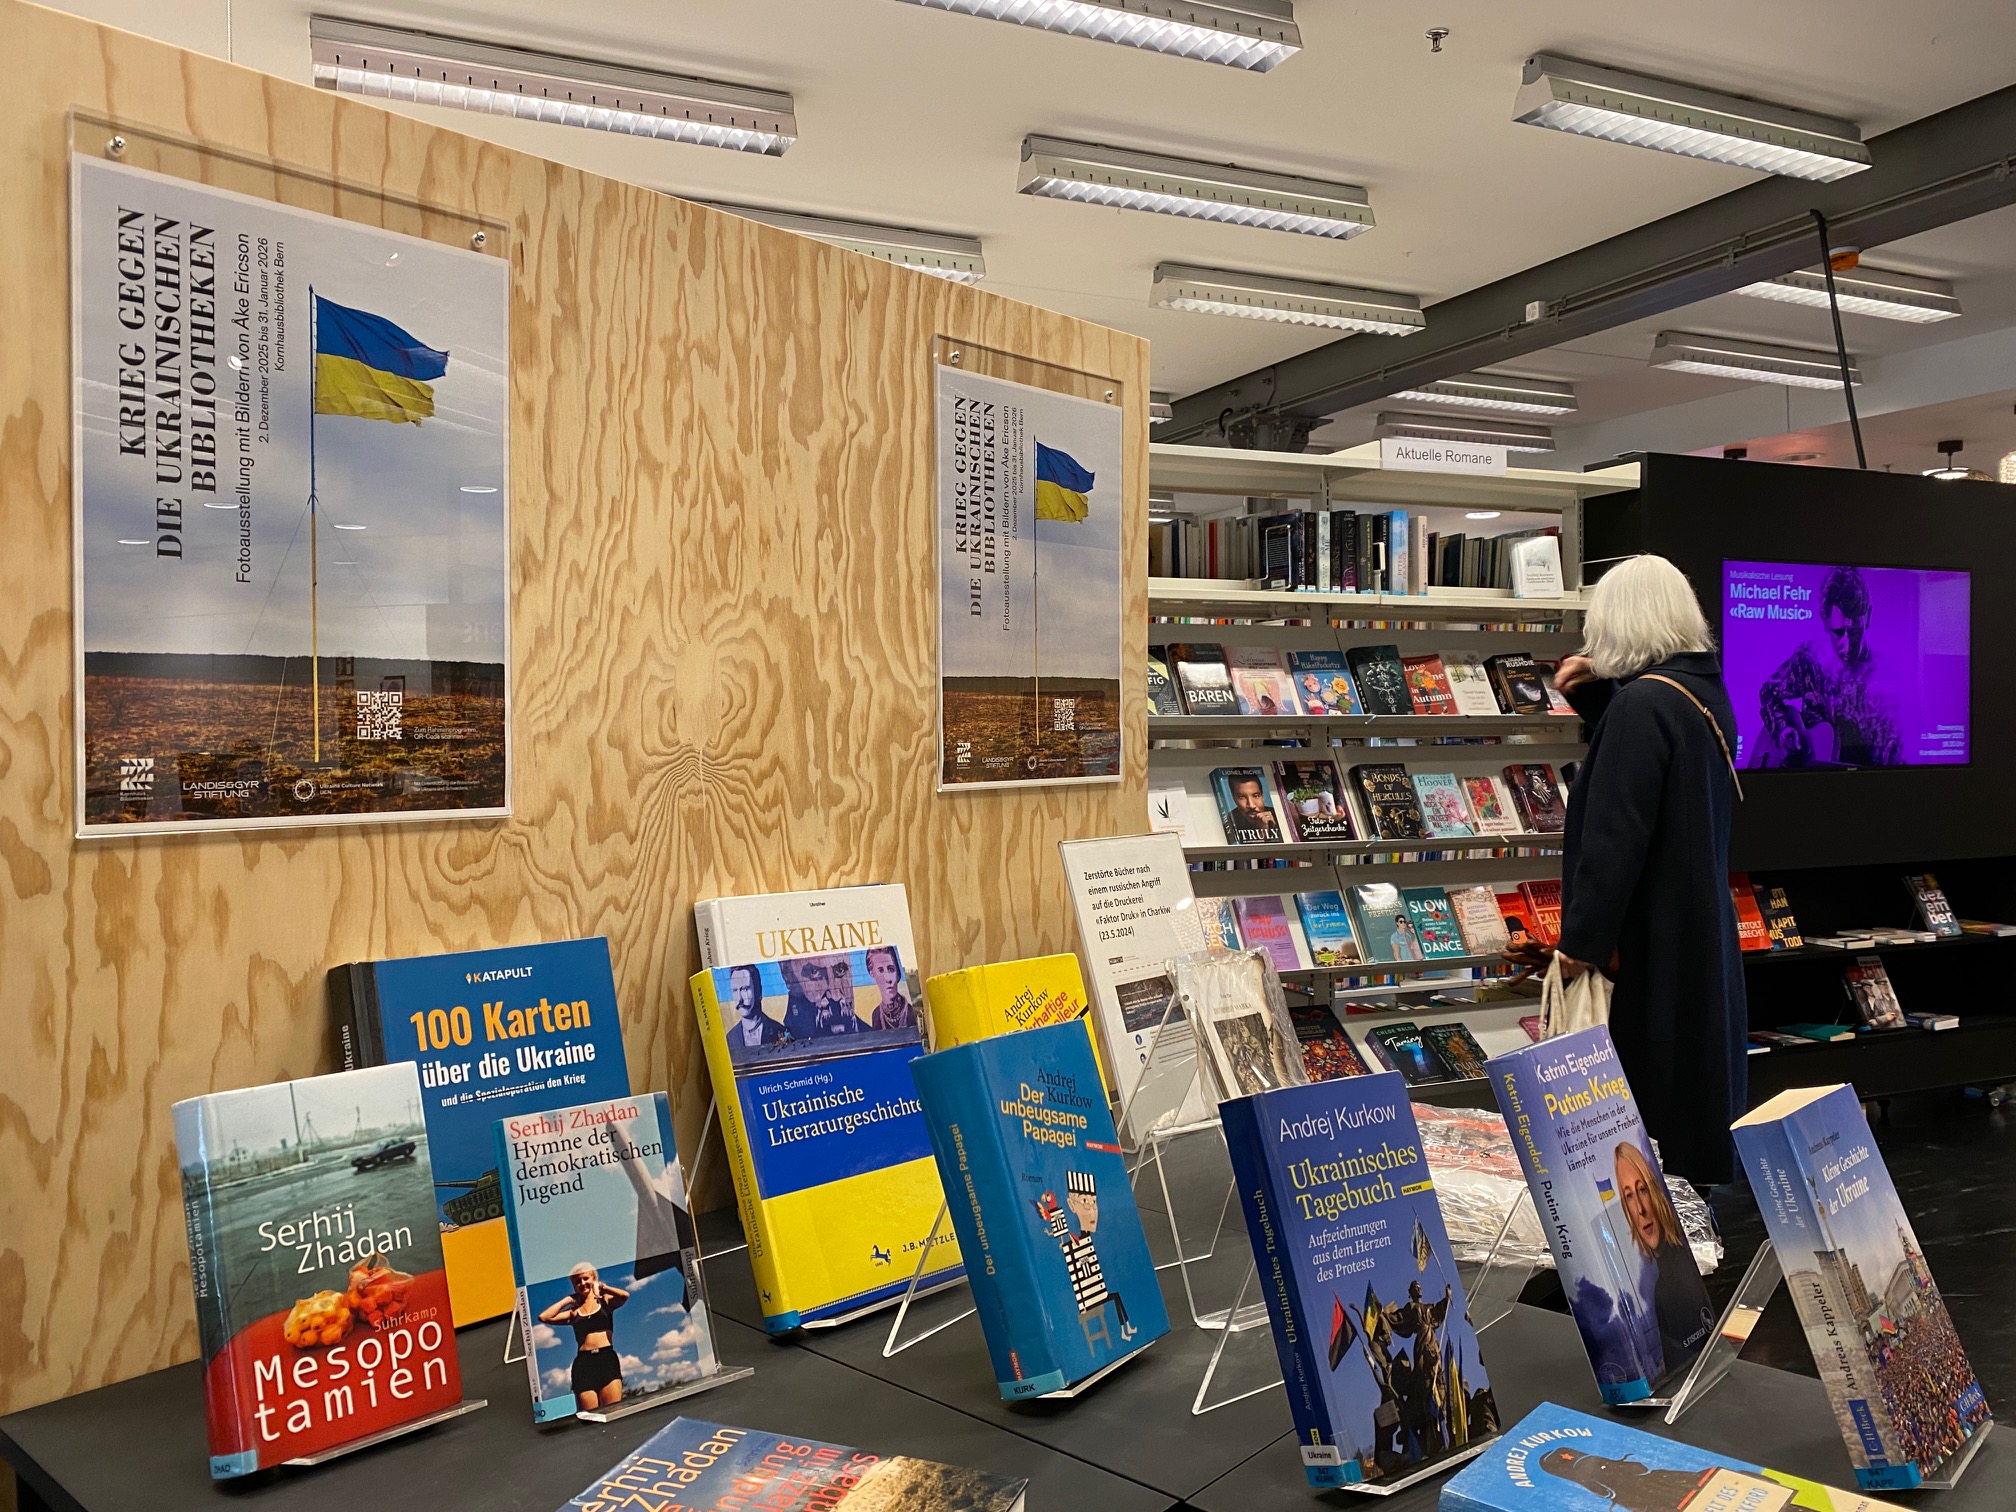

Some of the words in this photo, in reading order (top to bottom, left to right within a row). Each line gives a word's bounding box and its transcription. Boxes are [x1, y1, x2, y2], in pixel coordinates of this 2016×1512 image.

[118, 205, 145, 330] GEGEN
[234, 234, 250, 294] Ericson
[258, 238, 268, 268] 2026
[274, 242, 284, 268] Bern
[258, 272, 268, 307] Januar
[231, 298, 250, 330] Åke
[258, 311, 268, 324] 31.
[274, 270, 284, 372] Kornhausbibliothek
[154, 213, 182, 484] UKRAINISCHEN
[239, 334, 250, 362] von
[258, 327, 269, 342] bis
[189, 222, 216, 494] BIBLIOTHEKEN
[258, 344, 269, 374] 2025
[118, 343, 146, 458] KRIEG
[234, 366, 250, 423] Bildern
[258, 375, 270, 431] Dezember
[235, 427, 250, 453] mit
[955, 395, 967, 473] GEGEN
[1396, 447, 1442, 461] Aktuelle
[1446, 450, 1492, 464] Romane
[969, 399, 981, 570] UKRAINISCHEN
[984, 403, 995, 574] BIBLIOTHEKEN
[156, 497, 183, 560] DIE
[236, 457, 254, 583] Fotoausstellung
[956, 482, 967, 553] KRIEG
[971, 578, 981, 617] DIE
[1003, 552, 1011, 631] Fotoausstellung
[1730, 582, 1780, 600] Michael
[1784, 586, 1812, 600] Fehr
[1730, 603, 1764, 619] «Raw
[1768, 604, 1812, 620] Music»
[1189, 690, 1234, 702] BÄREN
[1413, 692, 1452, 704] Autumn
[183, 781, 259, 791] LANDIS&GYR
[194, 790, 249, 798] STIFTUNG
[1371, 773, 1401, 783] BONDS
[1372, 792, 1412, 801] HERCULES
[1238, 828, 1279, 840] TRULY
[1084, 870, 1113, 880] Zerstörte
[1114, 867, 1135, 876] Bücher
[1137, 864, 1150, 873] nach
[1088, 886, 1108, 895] einem
[1109, 881, 1140, 892] russischen
[1142, 877, 1161, 888] Angriff
[1092, 900, 1102, 910] auf
[1104, 899, 1114, 908] die
[1115, 894, 1144, 907] Druckerei
[1305, 904, 1320, 912] Der
[1322, 903, 1338, 911] Weg
[1409, 899, 1447, 913] SLOW
[1919, 887, 1945, 901] dez
[1926, 901, 1950, 912] em
[1096, 915, 1119, 925] «Faktor
[1121, 911, 1139, 921] Druk»
[1140, 910, 1146, 918] in
[1147, 906, 1170, 916] Charkiw
[1739, 929, 1765, 938] BRECHT
[1928, 912, 1952, 925] ber
[755, 920, 883, 959] UKRAINE
[1099, 926, 1134, 942] (23.5.2024)
[1423, 940, 1463, 953] DANCE
[473, 966, 532, 983] KATAPULT
[1005, 986, 1033, 1022] Andrej
[1015, 989, 1048, 1027] Kurkow
[410, 1006, 472, 1052] 100
[482, 998, 591, 1042] Karten
[1384, 1036, 1422, 1052] Taming
[1534, 1059, 1568, 1084] Katrin
[1565, 1039, 1614, 1075] Eigendorf
[422, 1062, 471, 1088] über
[479, 1052, 510, 1079] die
[516, 1041, 596, 1072] Ukraine
[1037, 1068, 1077, 1092] Andrej
[442, 1095, 458, 1107] und
[546, 1077, 562, 1088] den
[564, 1073, 586, 1086] Krieg
[758, 1082, 783, 1095] Ulrich
[783, 1076, 813, 1092] Schmid
[815, 1073, 833, 1086] (Hg.)
[1020, 1083, 1044, 1104] Der
[1048, 1086, 1093, 1109] Kurkow
[1544, 1086, 1593, 1120] Putins
[1588, 1073, 1630, 1102] Krieg
[509, 1117, 565, 1140] Serhij
[570, 1104, 639, 1128] Zhadan
[762, 1085, 865, 1123] Ukrainische
[1001, 1099, 1088, 1130] unbeugsame
[1555, 1126, 1570, 1139] Wie
[1571, 1122, 1580, 1134] die
[1580, 1111, 1610, 1130] Menschen
[1609, 1107, 1616, 1119] in
[1616, 1103, 1626, 1115] der
[767, 1098, 922, 1147] Literaturgeschichte
[1023, 1120, 1077, 1149] Papagei
[1279, 1116, 1335, 1143] Andrej
[1338, 1102, 1397, 1131] Kurkow
[1561, 1139, 1588, 1155] Ukraine
[1587, 1133, 1597, 1145] für
[1598, 1127, 1617, 1140] unsere
[1616, 1114, 1640, 1131] Freiheit
[512, 1134, 583, 1162] Hymne
[588, 1126, 618, 1148] der
[516, 1139, 663, 1181] demokratischen
[728, 1104, 751, 1198] Literaturgeschichte
[949, 1124, 965, 1171] Papagei
[1566, 1152, 1596, 1172] kämpfen
[1288, 1141, 1419, 1191] Ukrainisches
[1504, 1073, 1523, 1113] Katrin
[1518, 1114, 1549, 1175] Eigendorf
[1541, 1181, 1560, 1222] Putins
[1556, 1224, 1572, 1259] Krieg
[1758, 1157, 1779, 1197] Geschichte
[1822, 1162, 1840, 1183] Kleine
[1839, 1146, 1869, 1172] Geschichte
[519, 1173, 584, 1206] Jugend
[1296, 1174, 1397, 1222] Tagebuch
[1779, 1167, 1799, 1213] Ukraine
[1829, 1199, 1840, 1215] der
[1836, 1175, 1869, 1207] Ukraine
[258, 1203, 357, 1252] Serhij
[964, 1174, 988, 1251] unbeugsame
[1253, 1189, 1275, 1253] Tagebuch
[1775, 1199, 1788, 1224] Kleine
[192, 1200, 208, 1298] Mesopotamien
[295, 1223, 413, 1275] Zhadan
[1308, 1217, 1388, 1249] Aufzeichnungen
[1313, 1250, 1331, 1266] aus
[1333, 1244, 1355, 1262] dem
[1355, 1234, 1392, 1256] Herzen
[684, 1250, 698, 1300] Suhrkamp
[986, 1254, 996, 1275] Der
[1317, 1267, 1335, 1283] des
[1338, 1257, 1376, 1279] Protests
[1271, 1257, 1298, 1344] Ukrainisches
[1811, 1281, 1840, 1337] Kappeler
[374, 1306, 438, 1333] Suhrkamp
[254, 1320, 443, 1401] Mesopo
[1838, 1334, 1857, 1390] Andreas
[254, 1356, 447, 1443] tamien
[1014, 1384, 1035, 1394] KURK
[1300, 1383, 1311, 1410] Andrej
[621, 1427, 748, 1512] Zhadan
[1506, 1447, 1535, 1488] ANDREJ
[1524, 1427, 1593, 1448] KURKOW
[1716, 1486, 1739, 1502] DES
